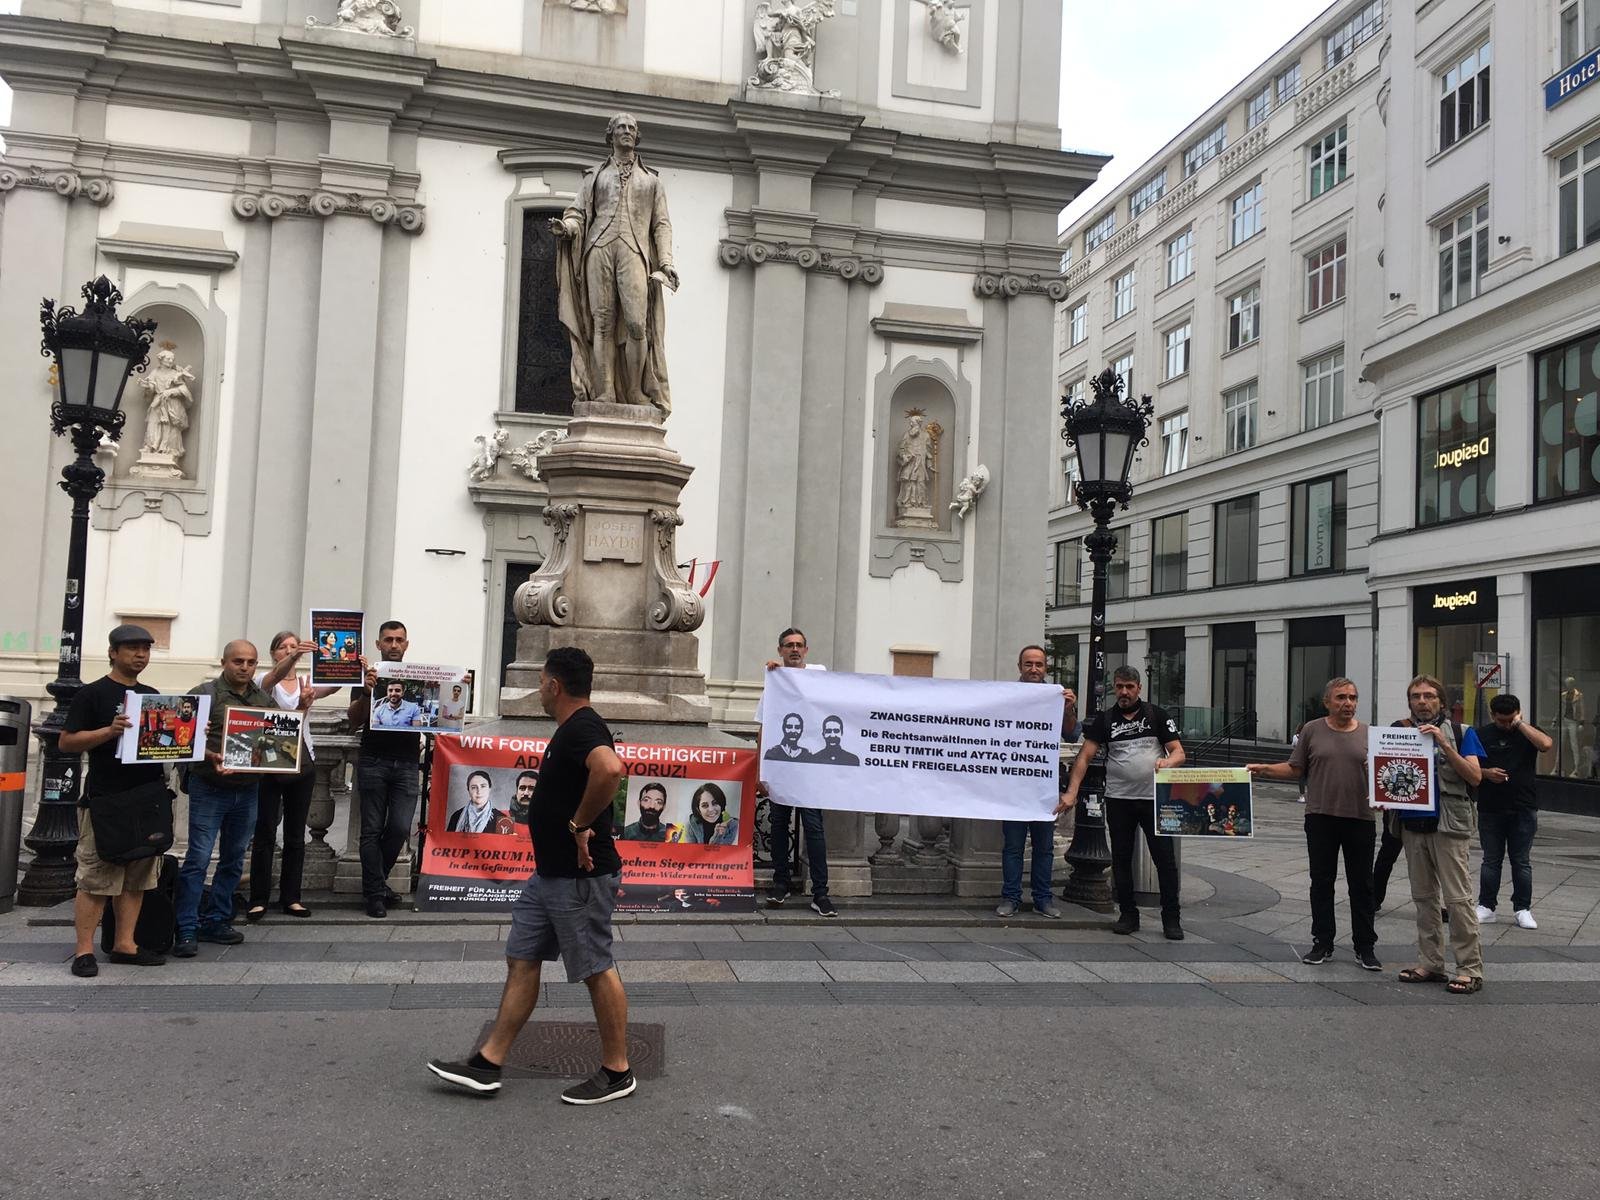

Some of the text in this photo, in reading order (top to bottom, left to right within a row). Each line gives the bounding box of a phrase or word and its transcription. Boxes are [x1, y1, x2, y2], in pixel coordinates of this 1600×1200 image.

[1560, 53, 1600, 97] Hotel
[870, 712, 1052, 731] ZWANGSERNÄHRUNG IST MORD!
[460, 735, 494, 750] WIR
[860, 729, 1059, 750] Die RechtsanwältInnen in der Türkei
[870, 744, 1049, 764] EBRU TIMTIK und AYTAÇ ÜNSAL
[623, 762, 687, 778] YORUZ!
[864, 757, 1052, 778] SOLLEN FREIGELASSEN WERDEN!
[432, 848, 470, 859] GRUP
[473, 849, 523, 861] YORUM
[659, 859, 685, 870] Sieg
[688, 862, 749, 872] errungen!
[462, 862, 479, 870] den
